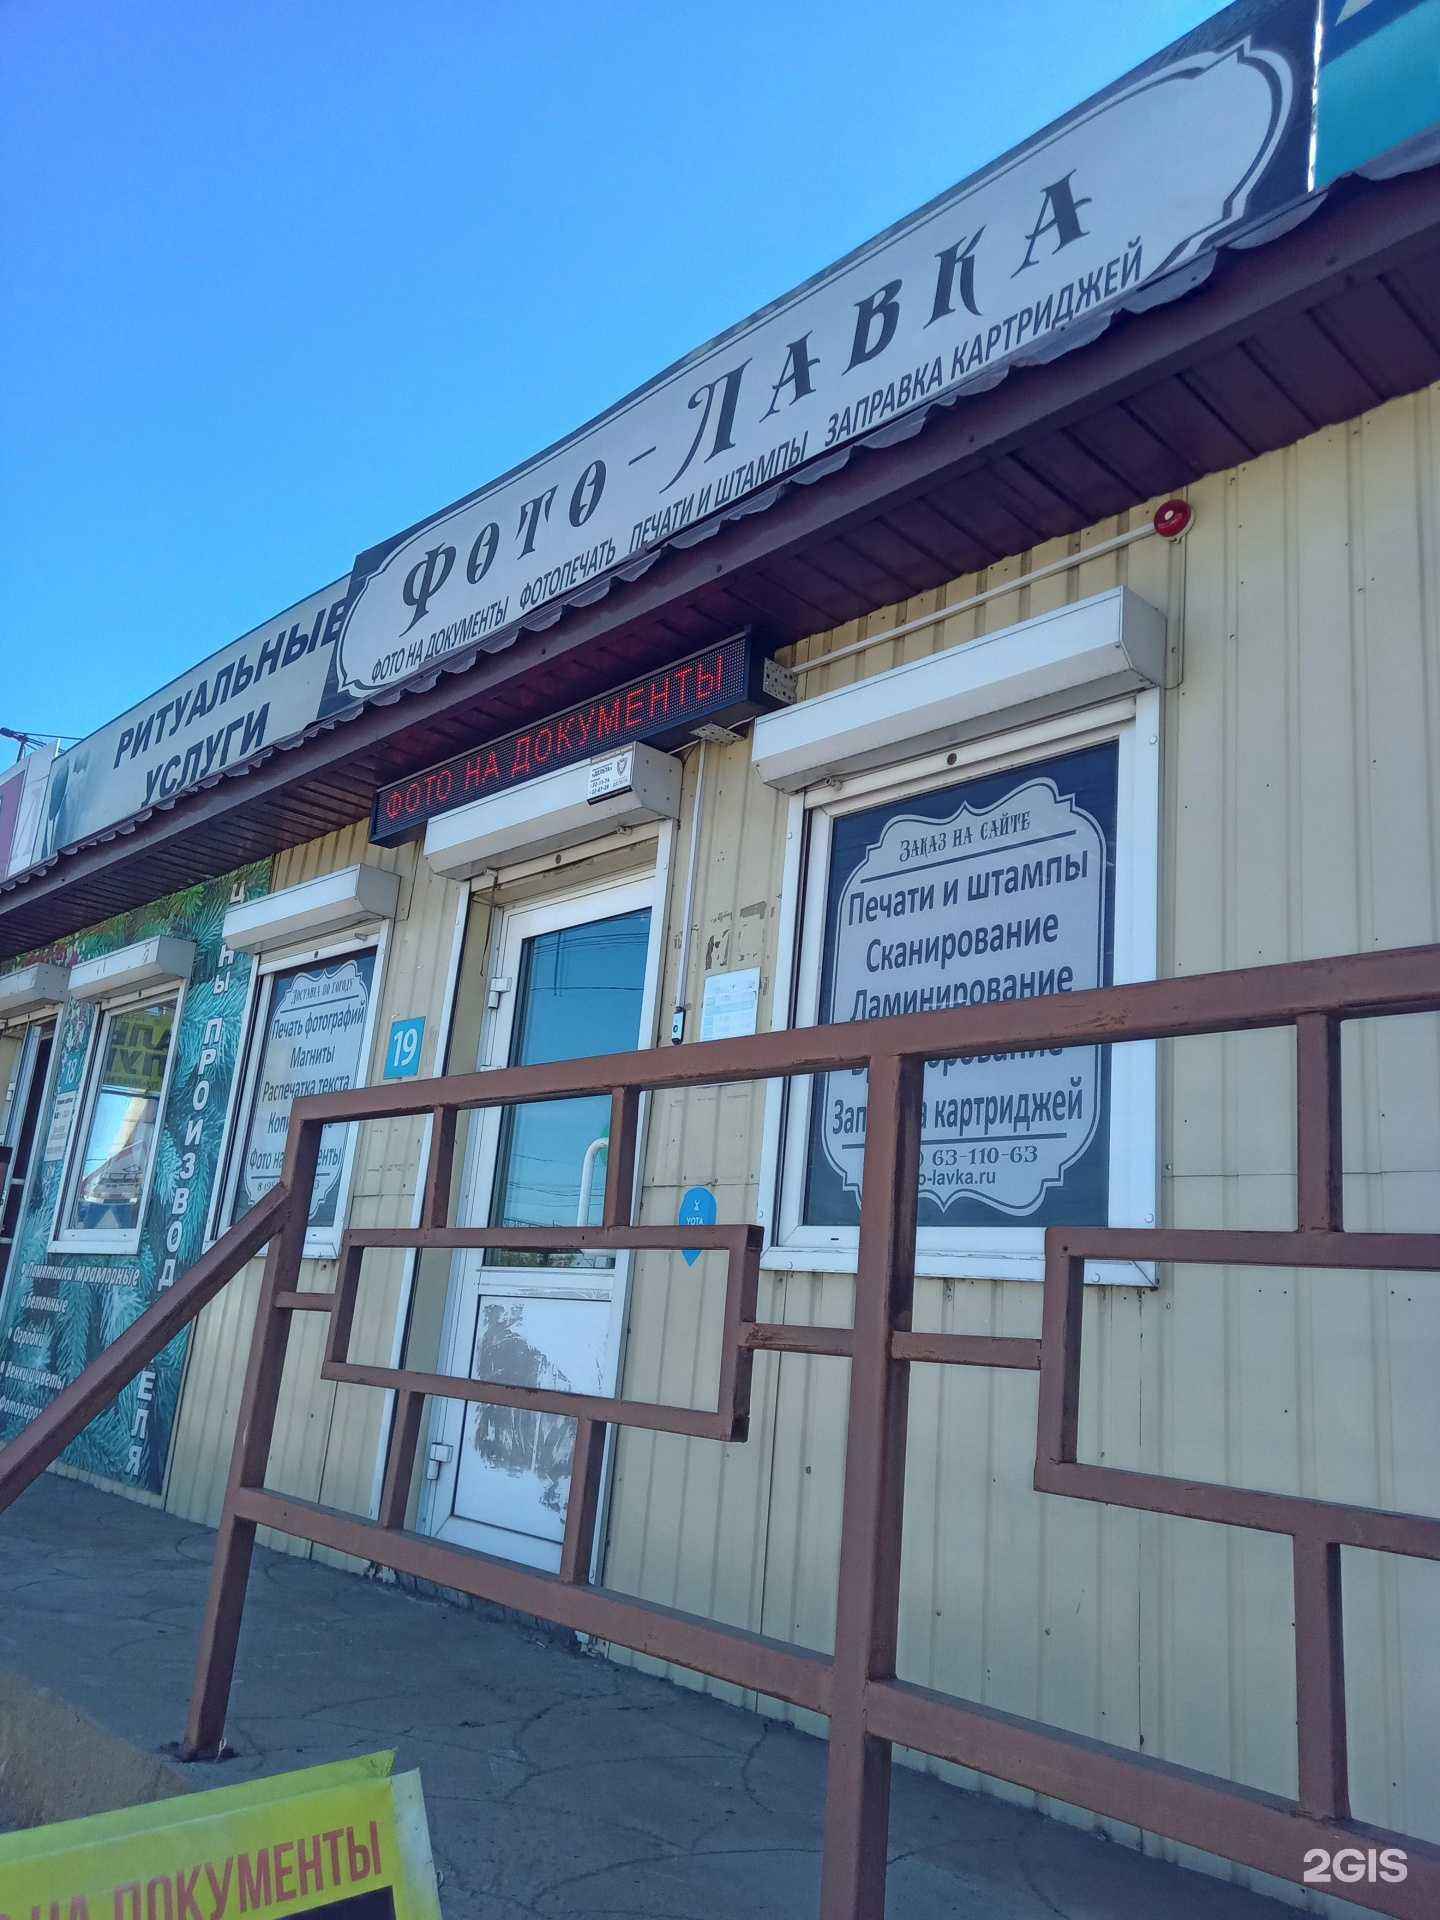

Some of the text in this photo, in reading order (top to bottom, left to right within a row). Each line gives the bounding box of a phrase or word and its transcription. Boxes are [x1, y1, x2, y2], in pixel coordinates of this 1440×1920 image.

[371, 235, 1145, 684] ФОТО НА ДОКУМЕНТЫ ФОТОПЕЧАТЬ ПЕЧАТИ И ШТАМПЫ ЗАПРАВКА КАРТРИДЖЕЙ
[113, 597, 350, 770] РИТУАЛЬНЫЕ
[141, 702, 271, 807] УСЛУГИ
[385, 654, 724, 819] ФОТО НА ДОКУМЕНТЫ
[952, 828, 973, 849] НА
[980, 809, 1032, 840] САЙТЕ
[848, 850, 1088, 926] Печати и штампы
[866, 913, 1060, 973] Сканирование
[850, 965, 1074, 1023] Ламинирование
[271, 999, 366, 1040] Печать фотографий
[289, 1045, 336, 1069] Магниты
[393, 1027, 418, 1068] 19
[261, 1075, 351, 1102] Распечатка текста
[933, 1075, 1083, 1137] картриджей
[249, 1148, 272, 1170] Фото
[917, 1169, 996, 1187] o-lavka.ru
[931, 1145, 1039, 1167] 63-110-63
